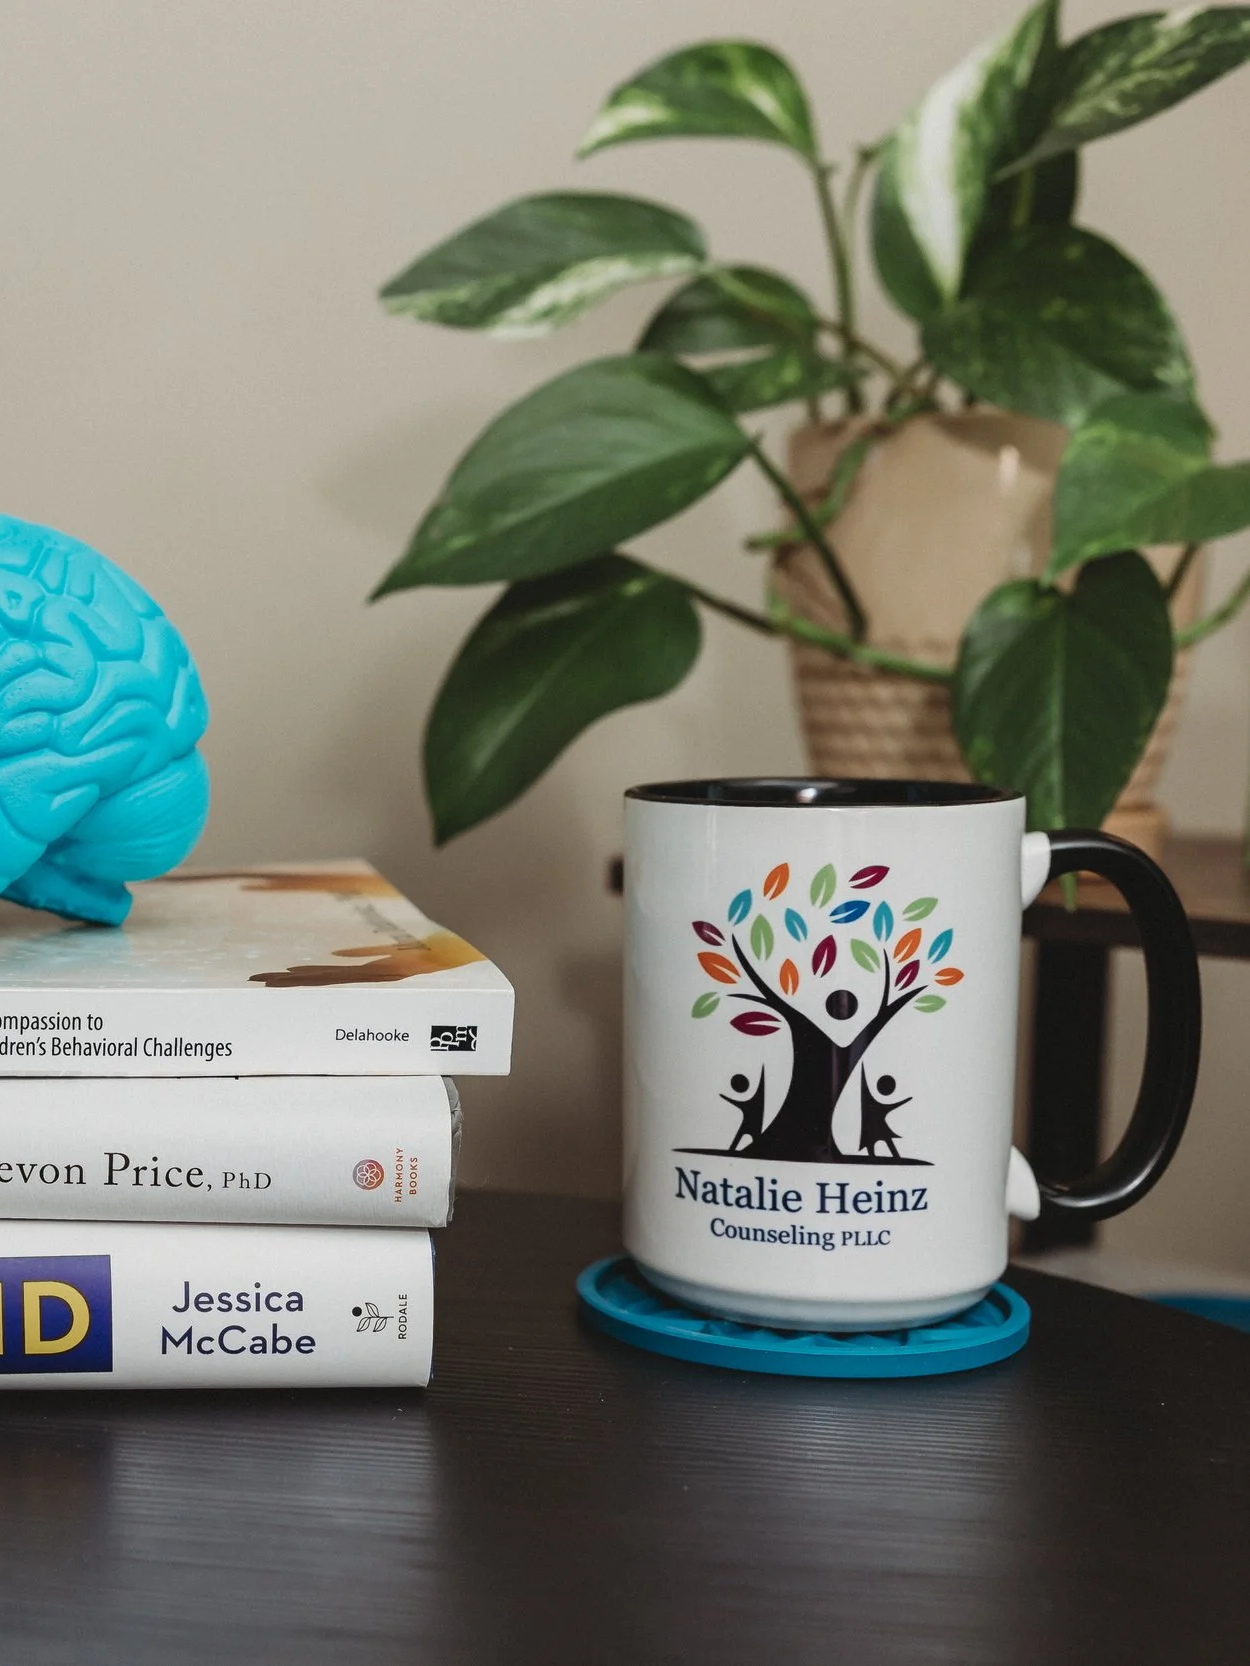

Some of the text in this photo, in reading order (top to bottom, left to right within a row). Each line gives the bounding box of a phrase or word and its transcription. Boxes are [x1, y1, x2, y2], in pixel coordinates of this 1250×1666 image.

[87, 1013, 104, 1031] to
[335, 1028, 410, 1042] Delahooke
[51, 1036, 138, 1057] Behavioral
[143, 1036, 233, 1062] Challenges
[103, 1152, 213, 1192] Price,
[222, 1171, 272, 1190] PhD
[394, 1148, 404, 1203] HARMONY
[408, 1157, 418, 1195] BOOKS
[674, 1166, 928, 1214] Natalie Heinz
[710, 1217, 891, 1252] Counseling PLLC
[171, 1281, 304, 1313] Jessica
[398, 1294, 408, 1340] RODALE
[161, 1323, 317, 1355] McCabe
